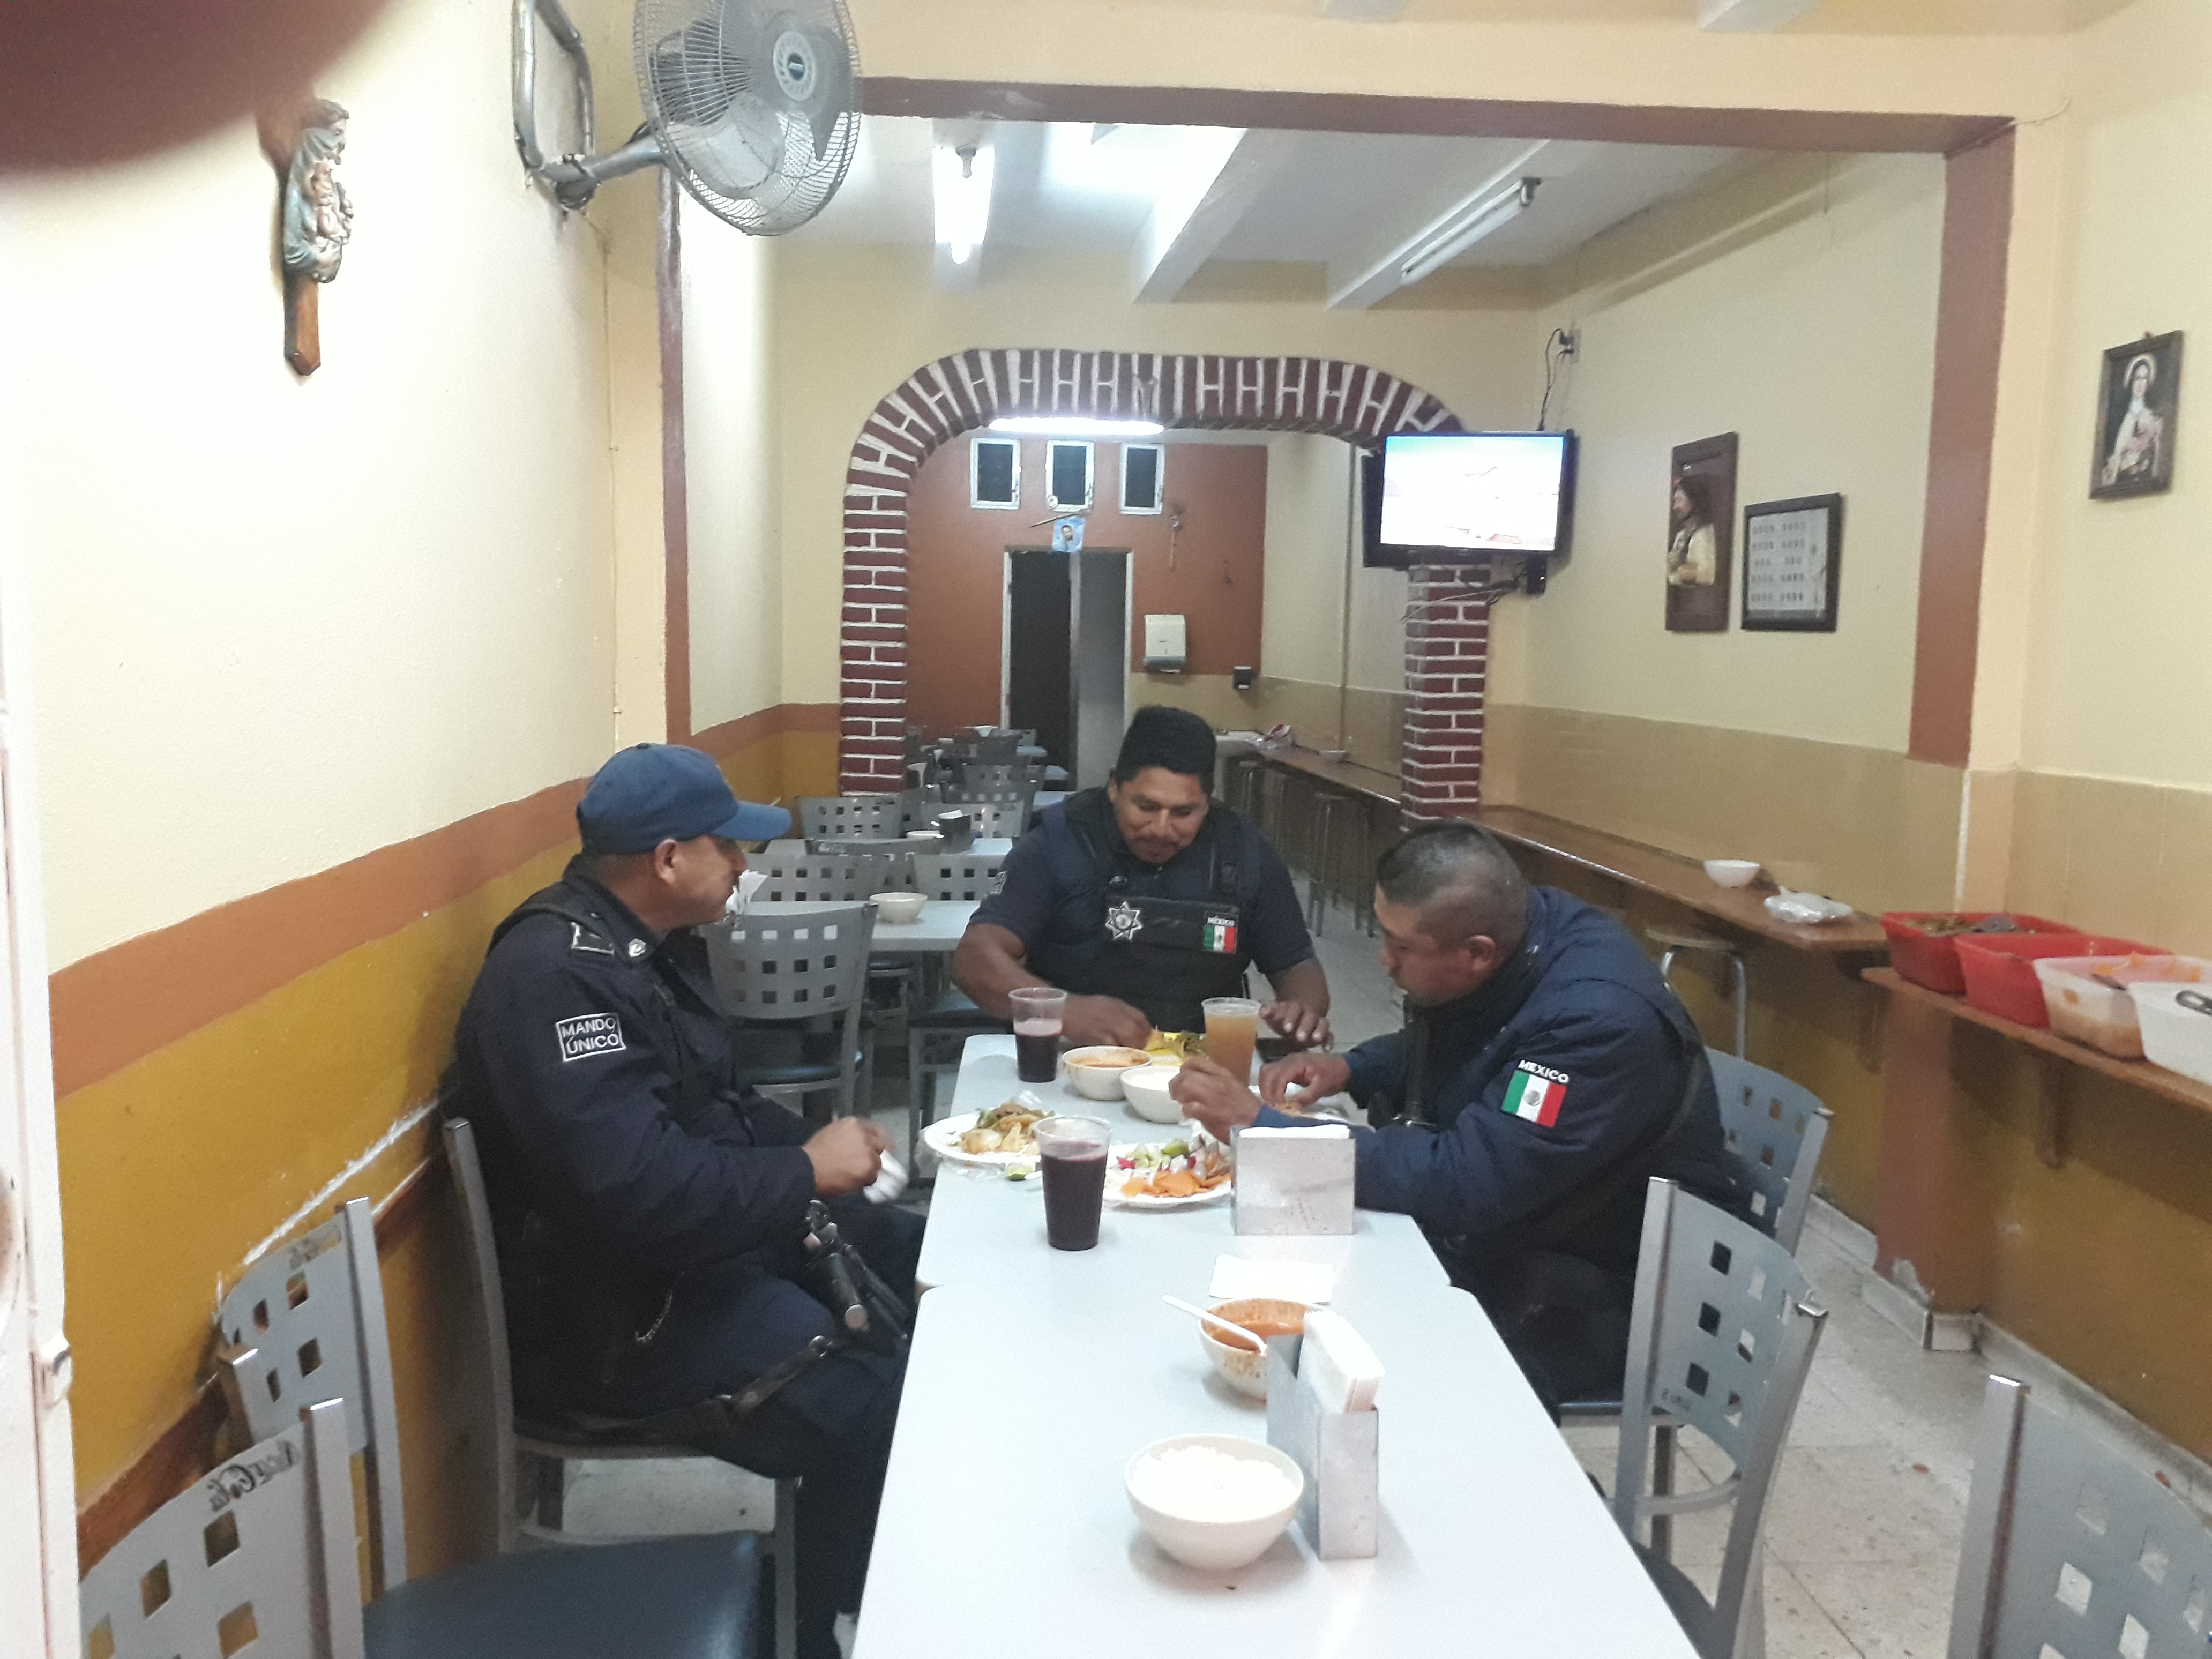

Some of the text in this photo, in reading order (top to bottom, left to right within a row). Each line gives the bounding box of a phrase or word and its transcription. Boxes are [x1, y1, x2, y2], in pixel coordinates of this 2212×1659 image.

[561, 1017, 616, 1037] MANDO
[566, 1034, 619, 1054] ÚNICO
[1518, 1059, 1570, 1083] MEXICO
